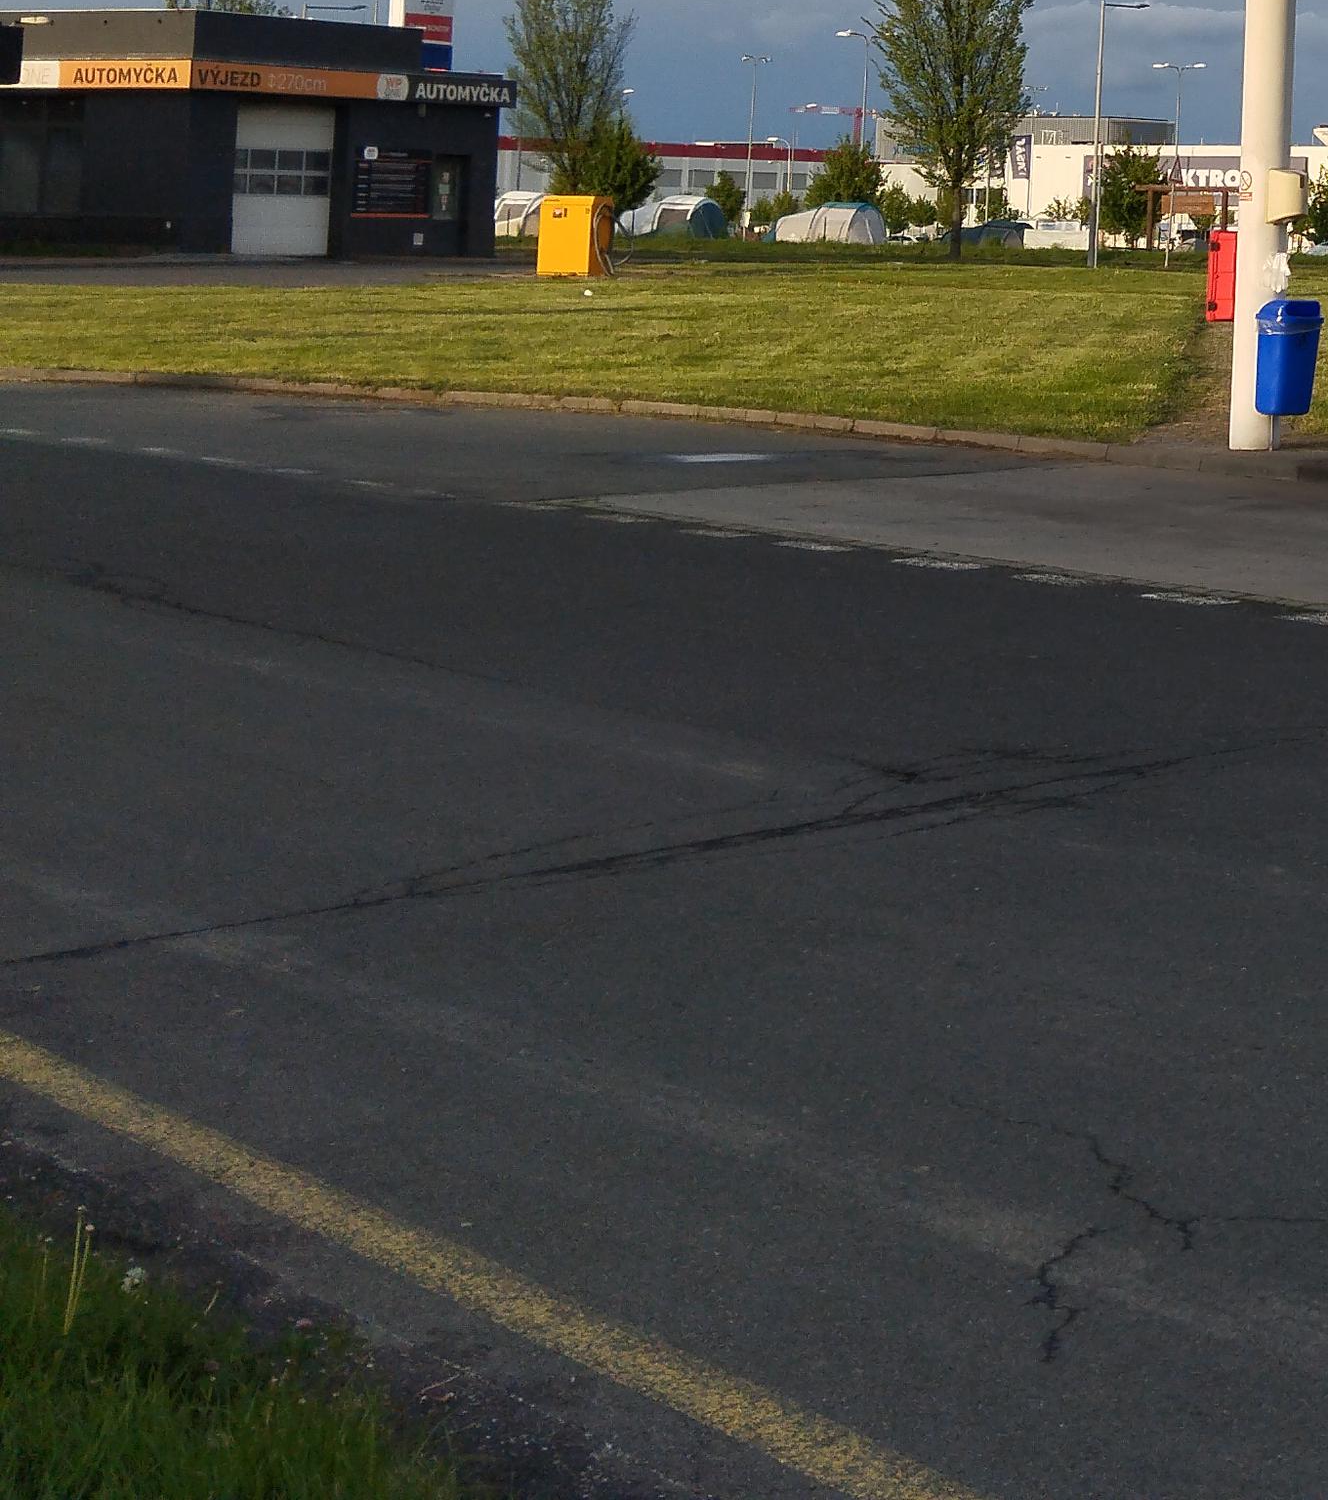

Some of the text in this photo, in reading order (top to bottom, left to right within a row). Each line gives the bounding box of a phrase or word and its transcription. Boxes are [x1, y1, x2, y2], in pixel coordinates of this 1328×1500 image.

[73, 63, 178, 85] AUTOMYČKA
[198, 65, 261, 88] VÝJEZD
[415, 82, 511, 103] AUTOMYČKA
[1158, 169, 1241, 188] KTRO
